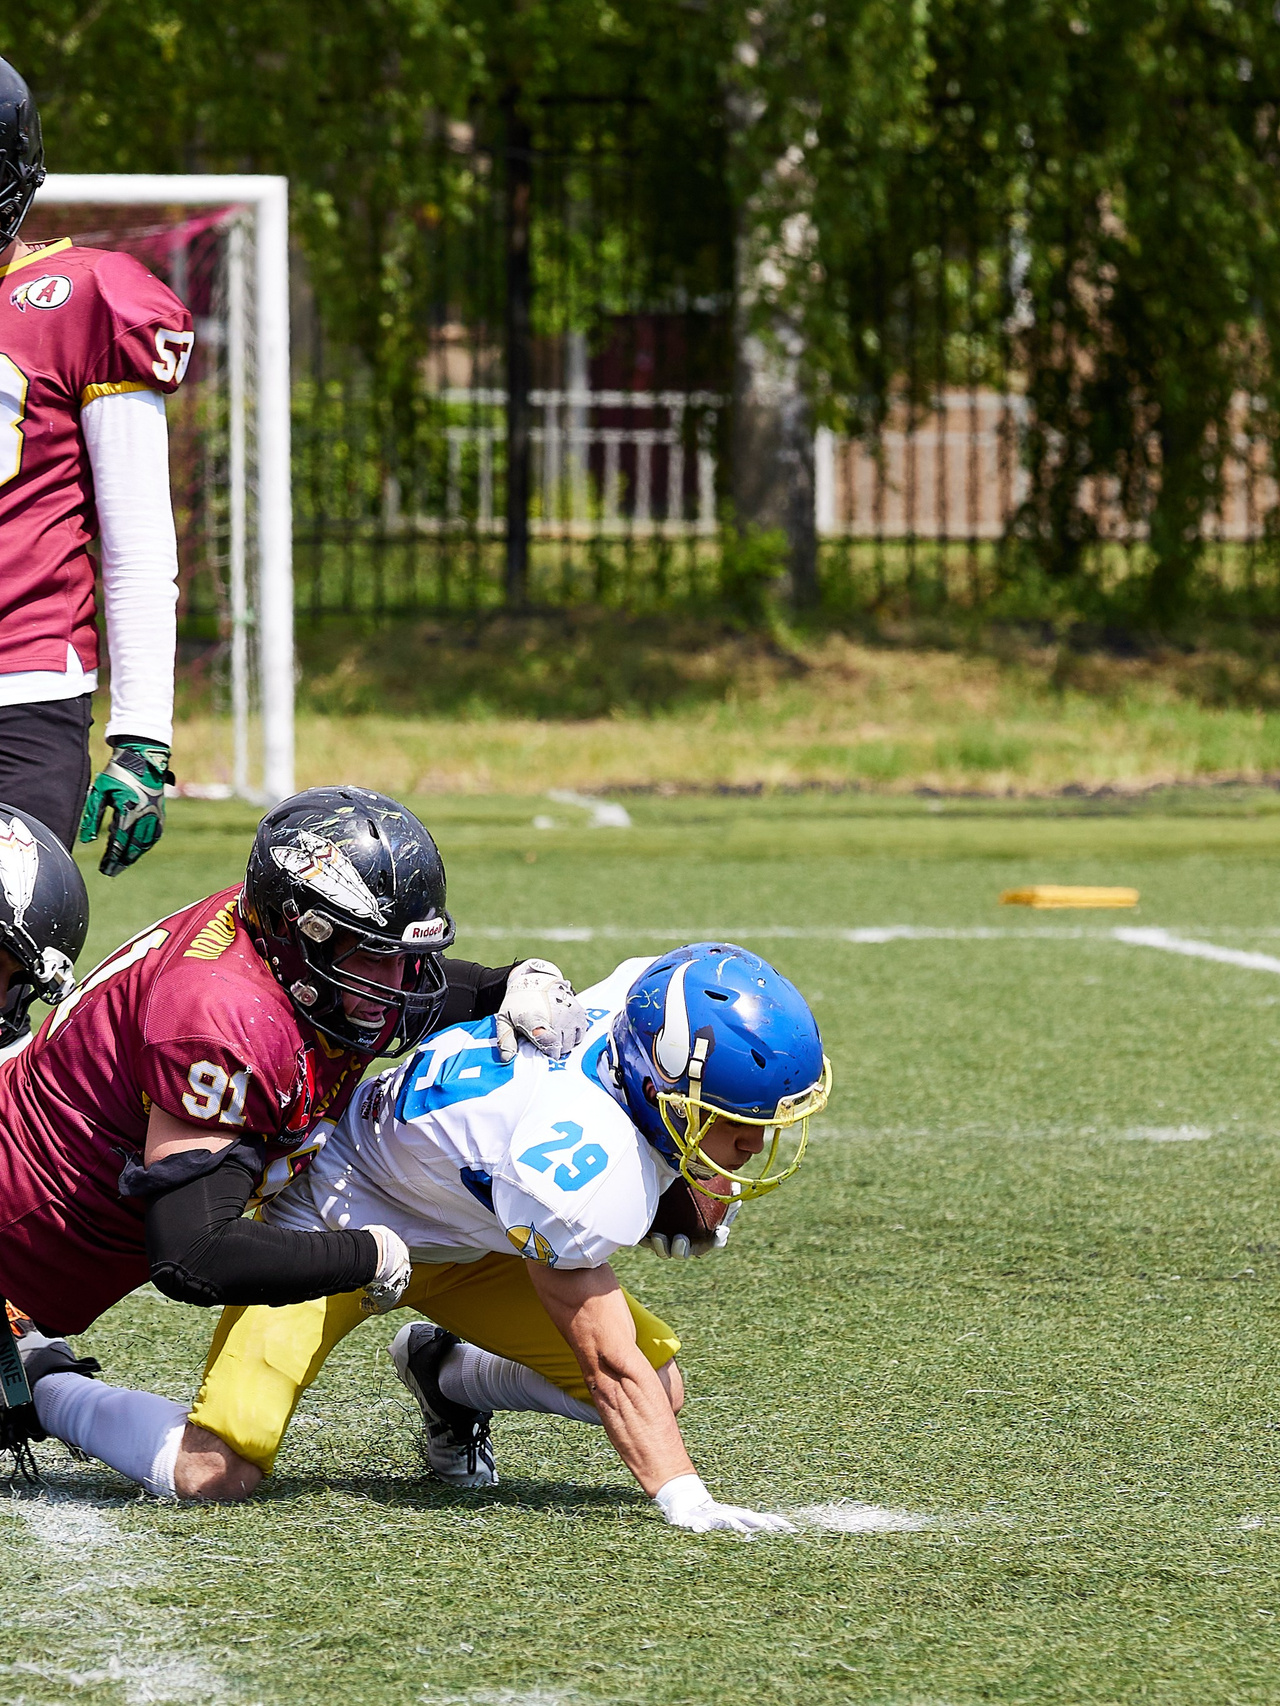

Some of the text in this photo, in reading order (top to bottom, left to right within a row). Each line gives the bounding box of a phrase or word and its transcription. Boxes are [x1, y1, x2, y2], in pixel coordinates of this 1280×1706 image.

[412, 922, 444, 939] Riddell
[181, 1060, 252, 1127] 91
[516, 1120, 609, 1192] 29
